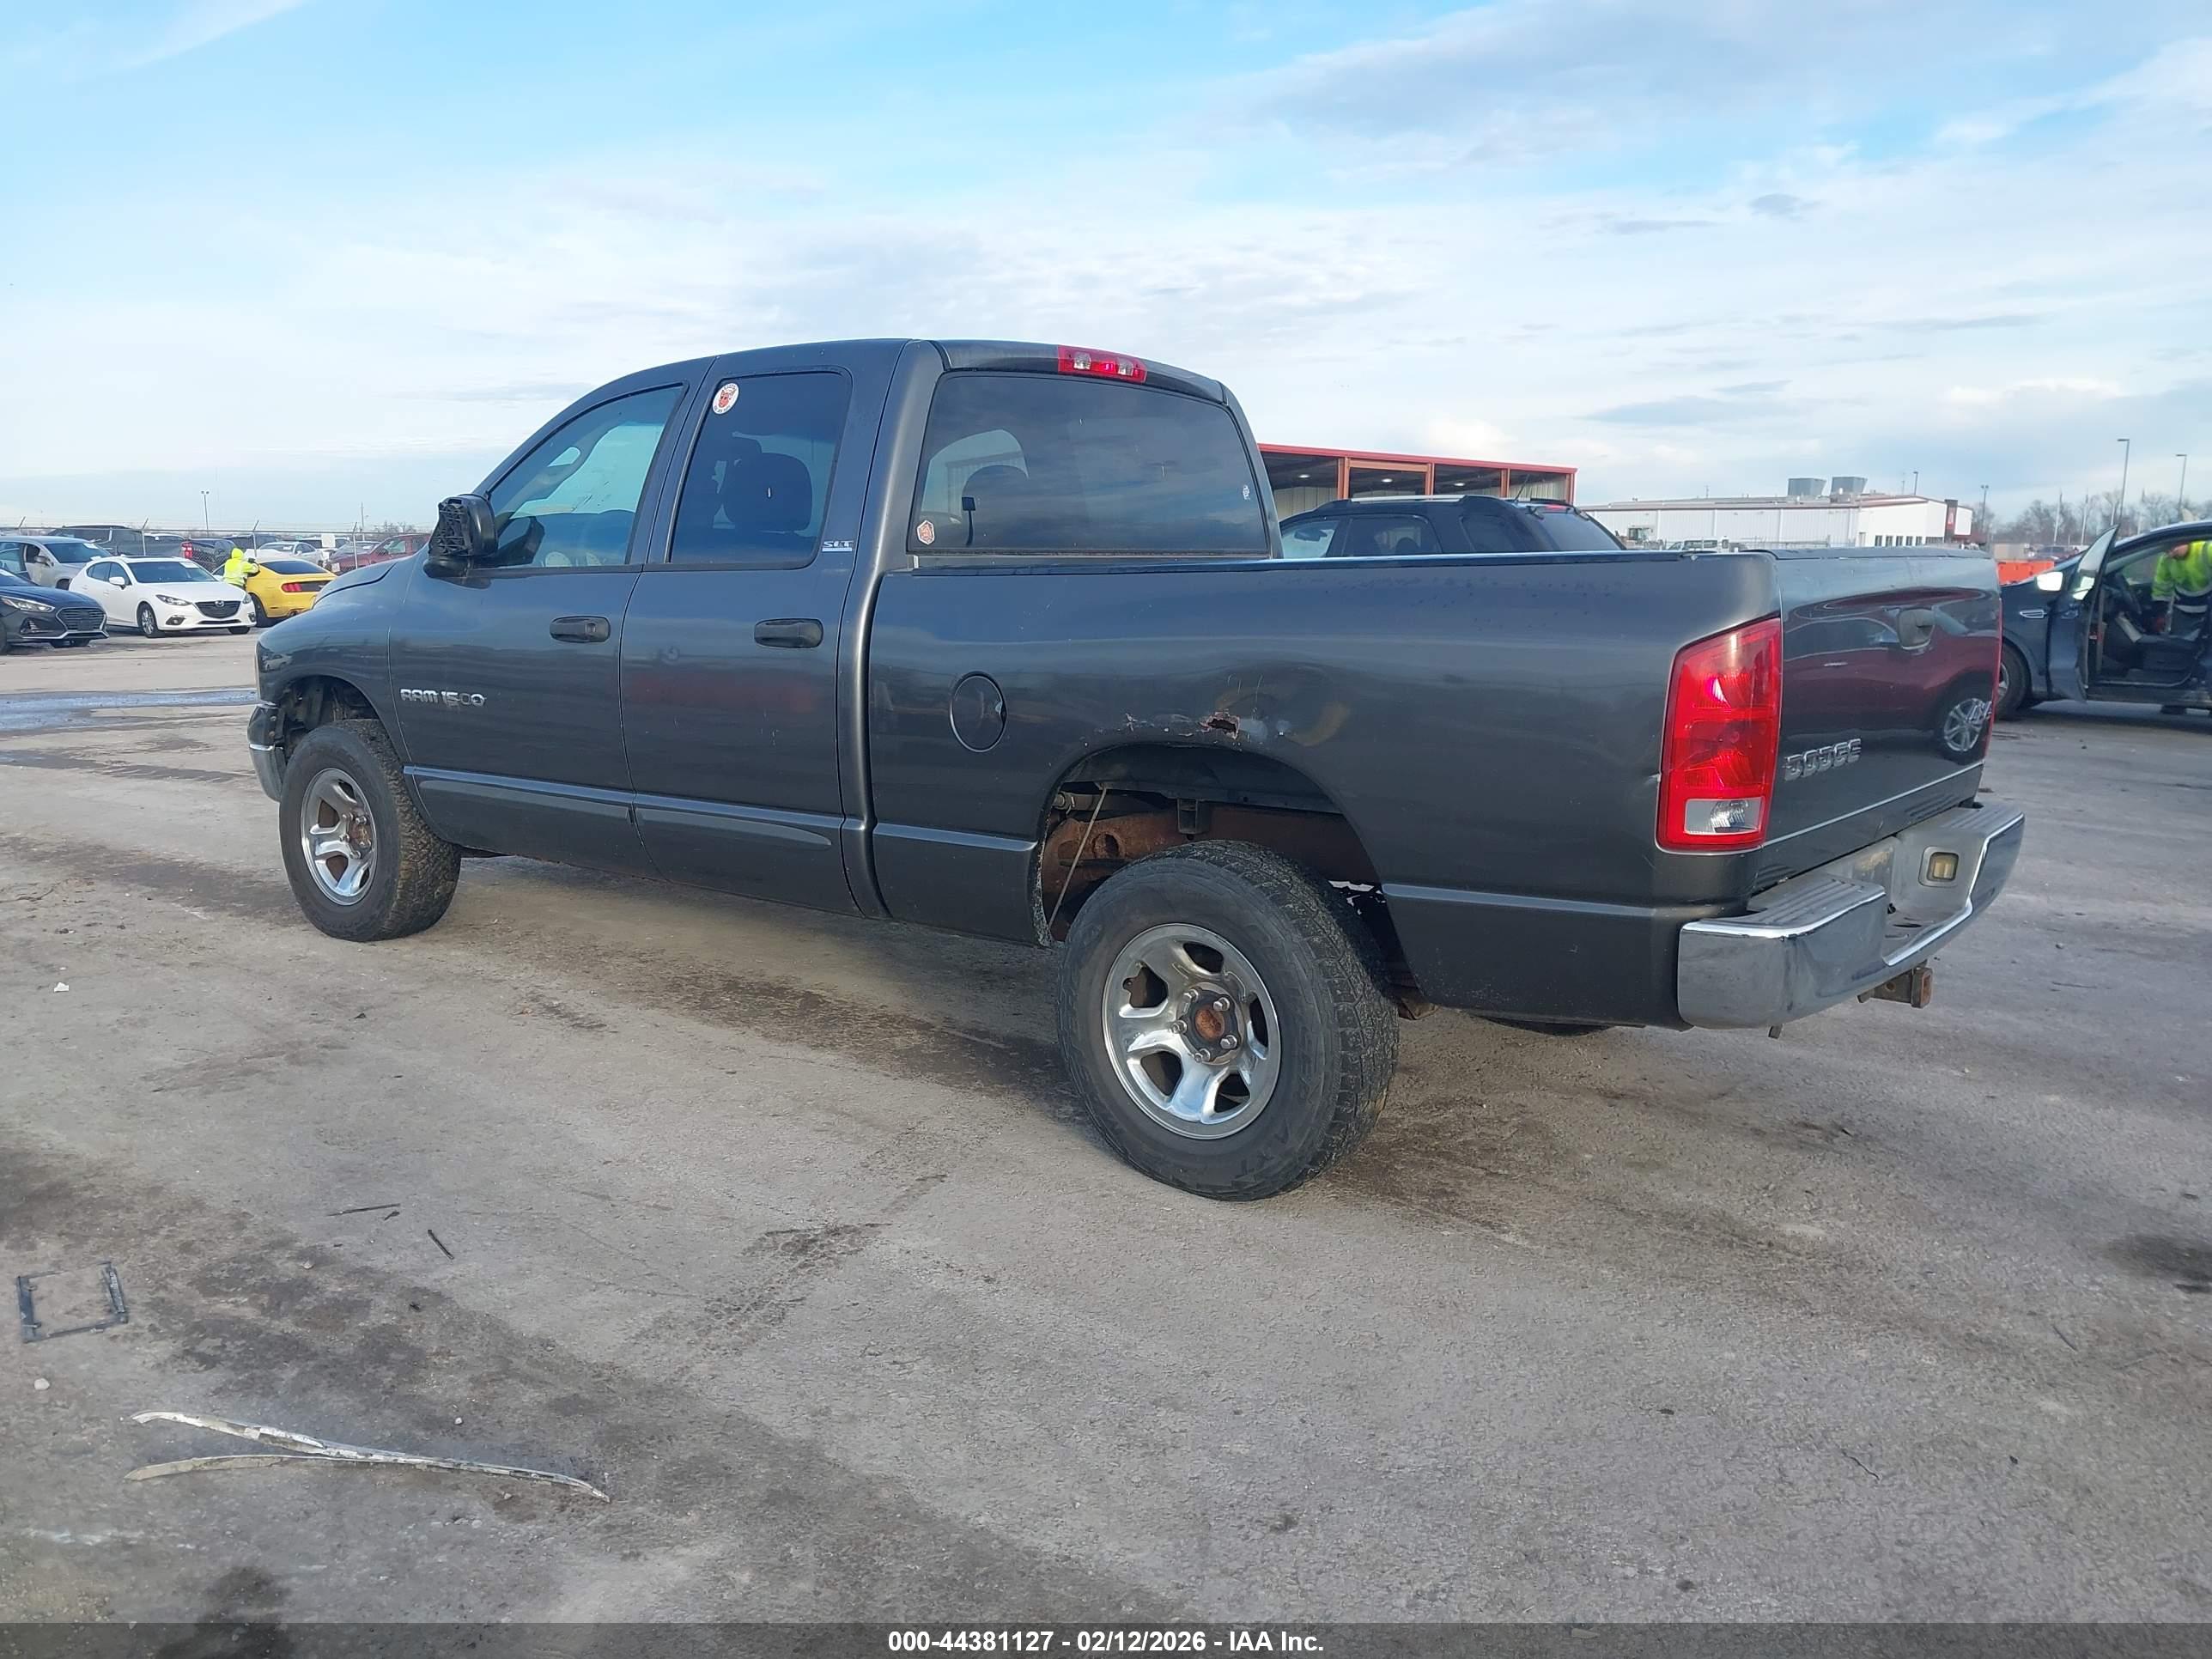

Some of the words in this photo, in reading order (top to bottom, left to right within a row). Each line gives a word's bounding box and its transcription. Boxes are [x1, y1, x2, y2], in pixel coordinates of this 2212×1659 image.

[400, 689, 439, 702] RAM
[441, 690, 486, 707] 1500
[1784, 738, 1862, 781] DODGE
